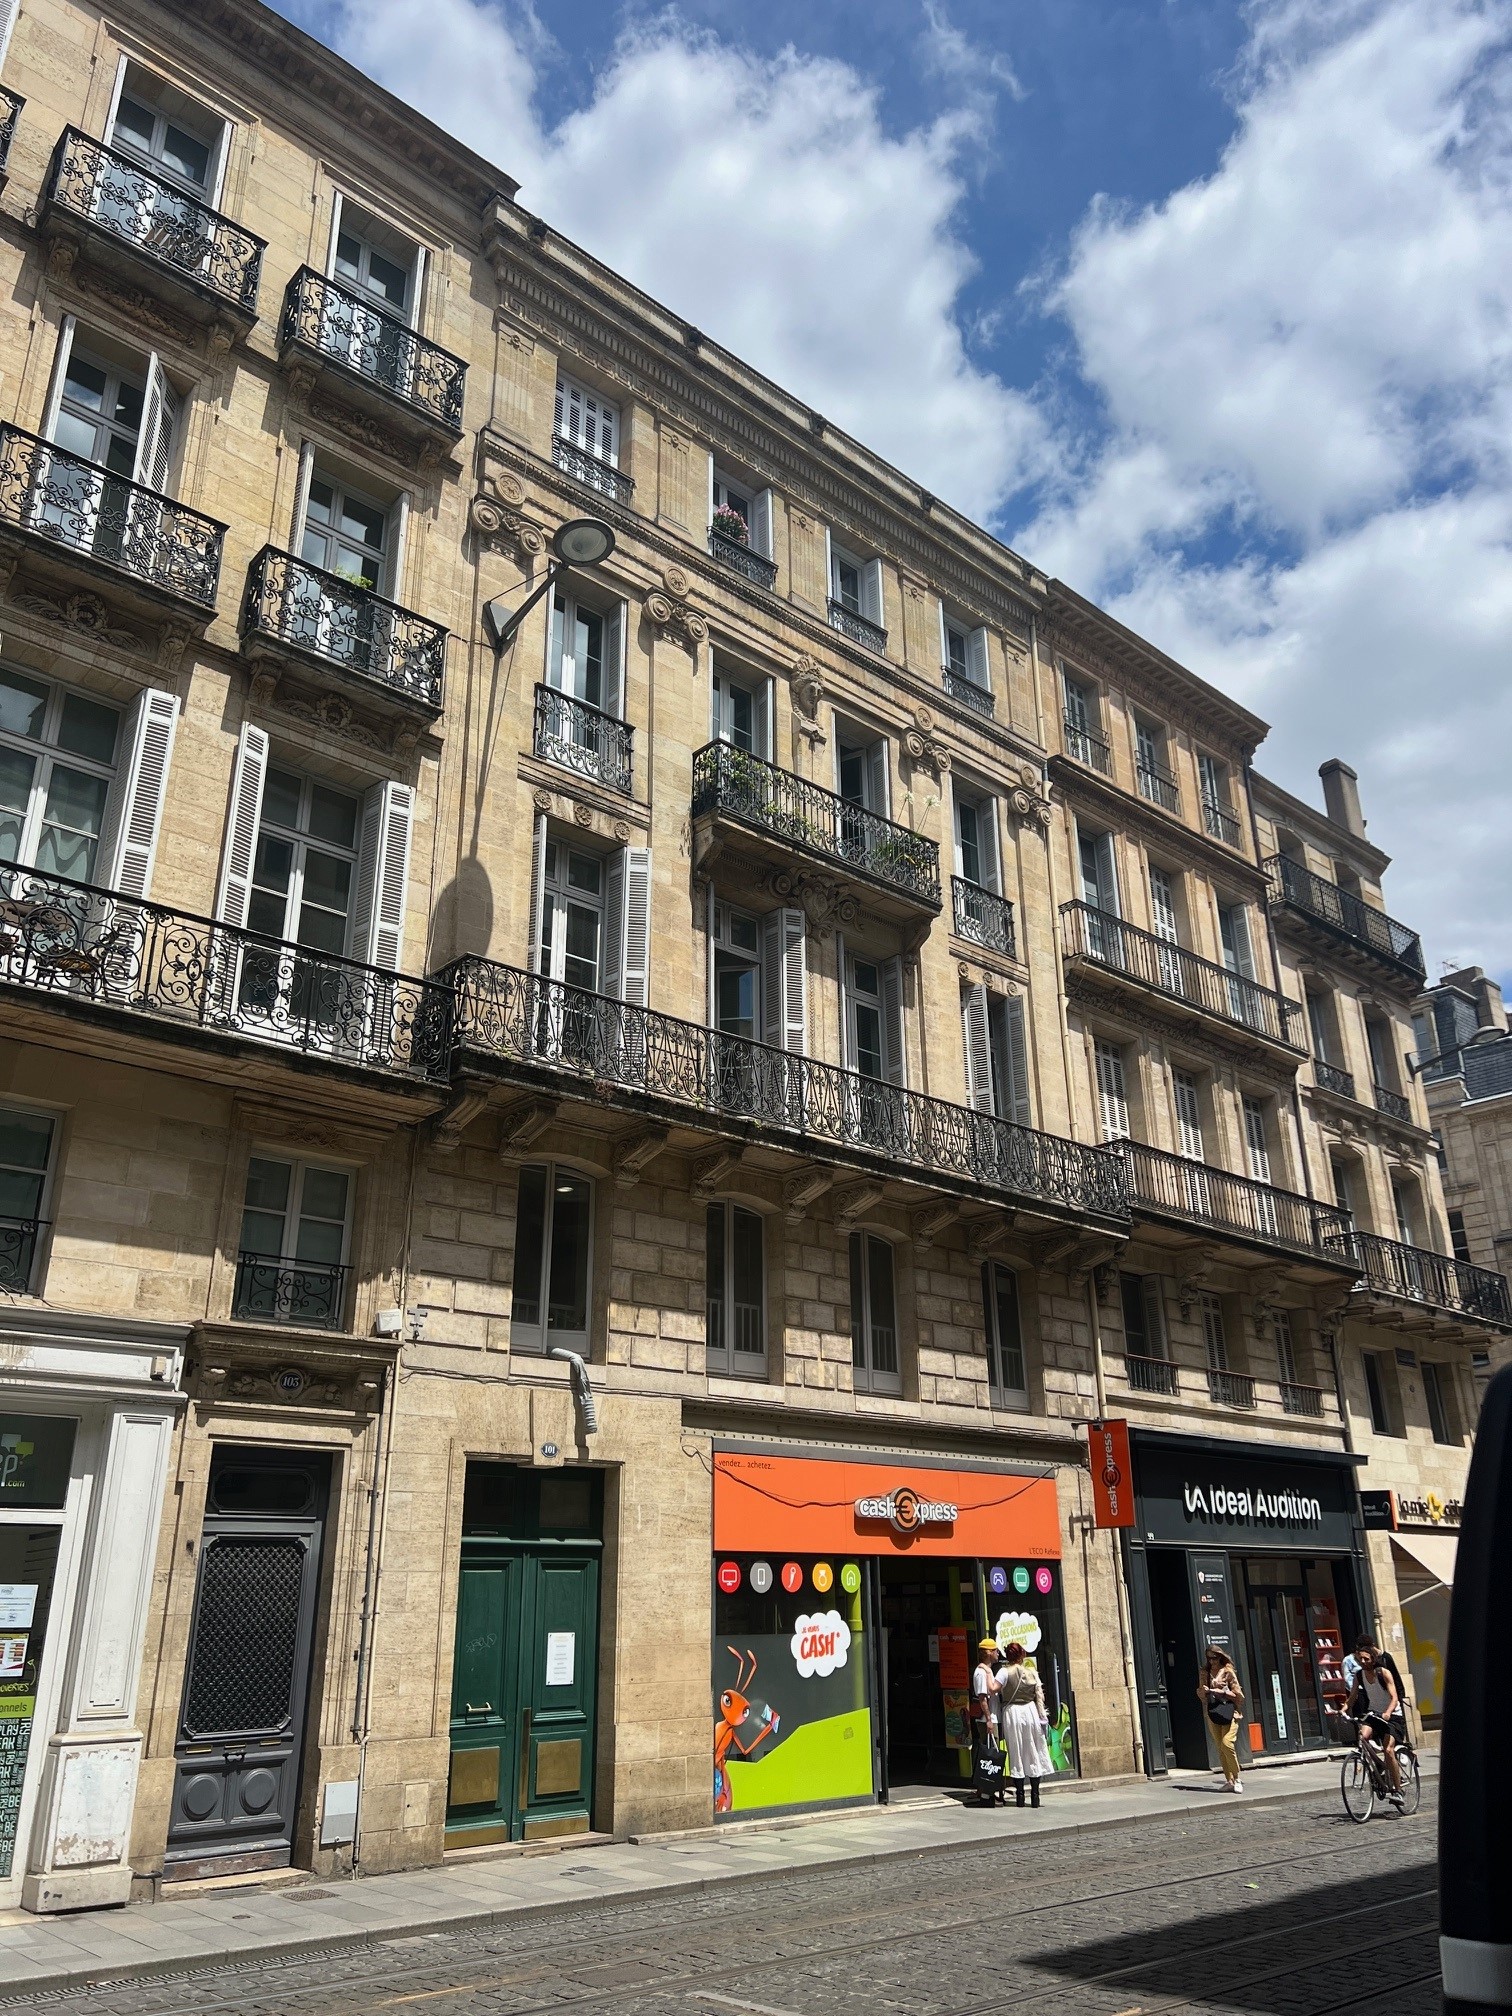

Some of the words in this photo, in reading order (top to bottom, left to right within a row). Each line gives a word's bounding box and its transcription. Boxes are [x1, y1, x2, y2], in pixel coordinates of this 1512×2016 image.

[283, 1376, 299, 1387] 103
[545, 1445, 556, 1454] 101
[1209, 1483, 1254, 1517] Ideal
[1256, 1488, 1322, 1521] Audition
[980, 1759, 1002, 1775] Edgar
[8, 1795, 21, 1808] BE
[5, 1821, 16, 1833] BE
[2, 1839, 14, 1853] BE
